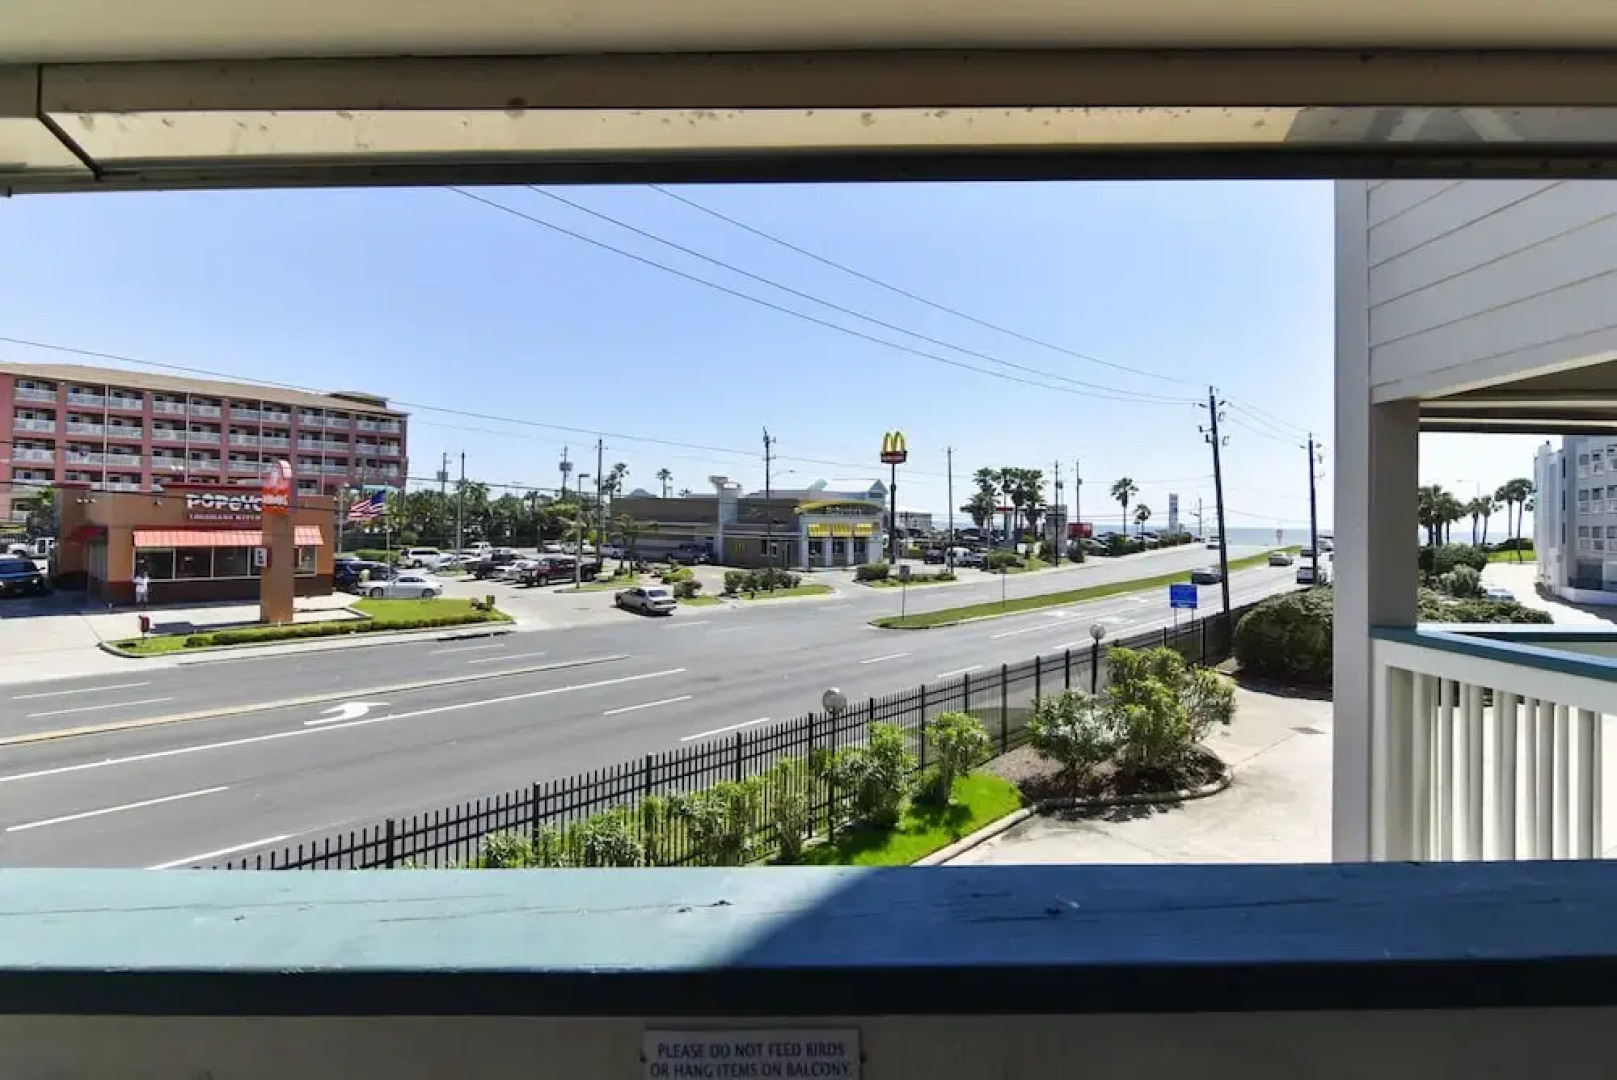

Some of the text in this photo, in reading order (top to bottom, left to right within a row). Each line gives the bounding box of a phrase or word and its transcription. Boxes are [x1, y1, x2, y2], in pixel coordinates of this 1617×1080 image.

[658, 1042, 845, 1059] PLEASE DO NOT FEED BIRDS
[650, 1063, 669, 1077] OR
[673, 1064, 713, 1079] HANG
[715, 1063, 758, 1078] ITEMS
[762, 1062, 783, 1077] ON
